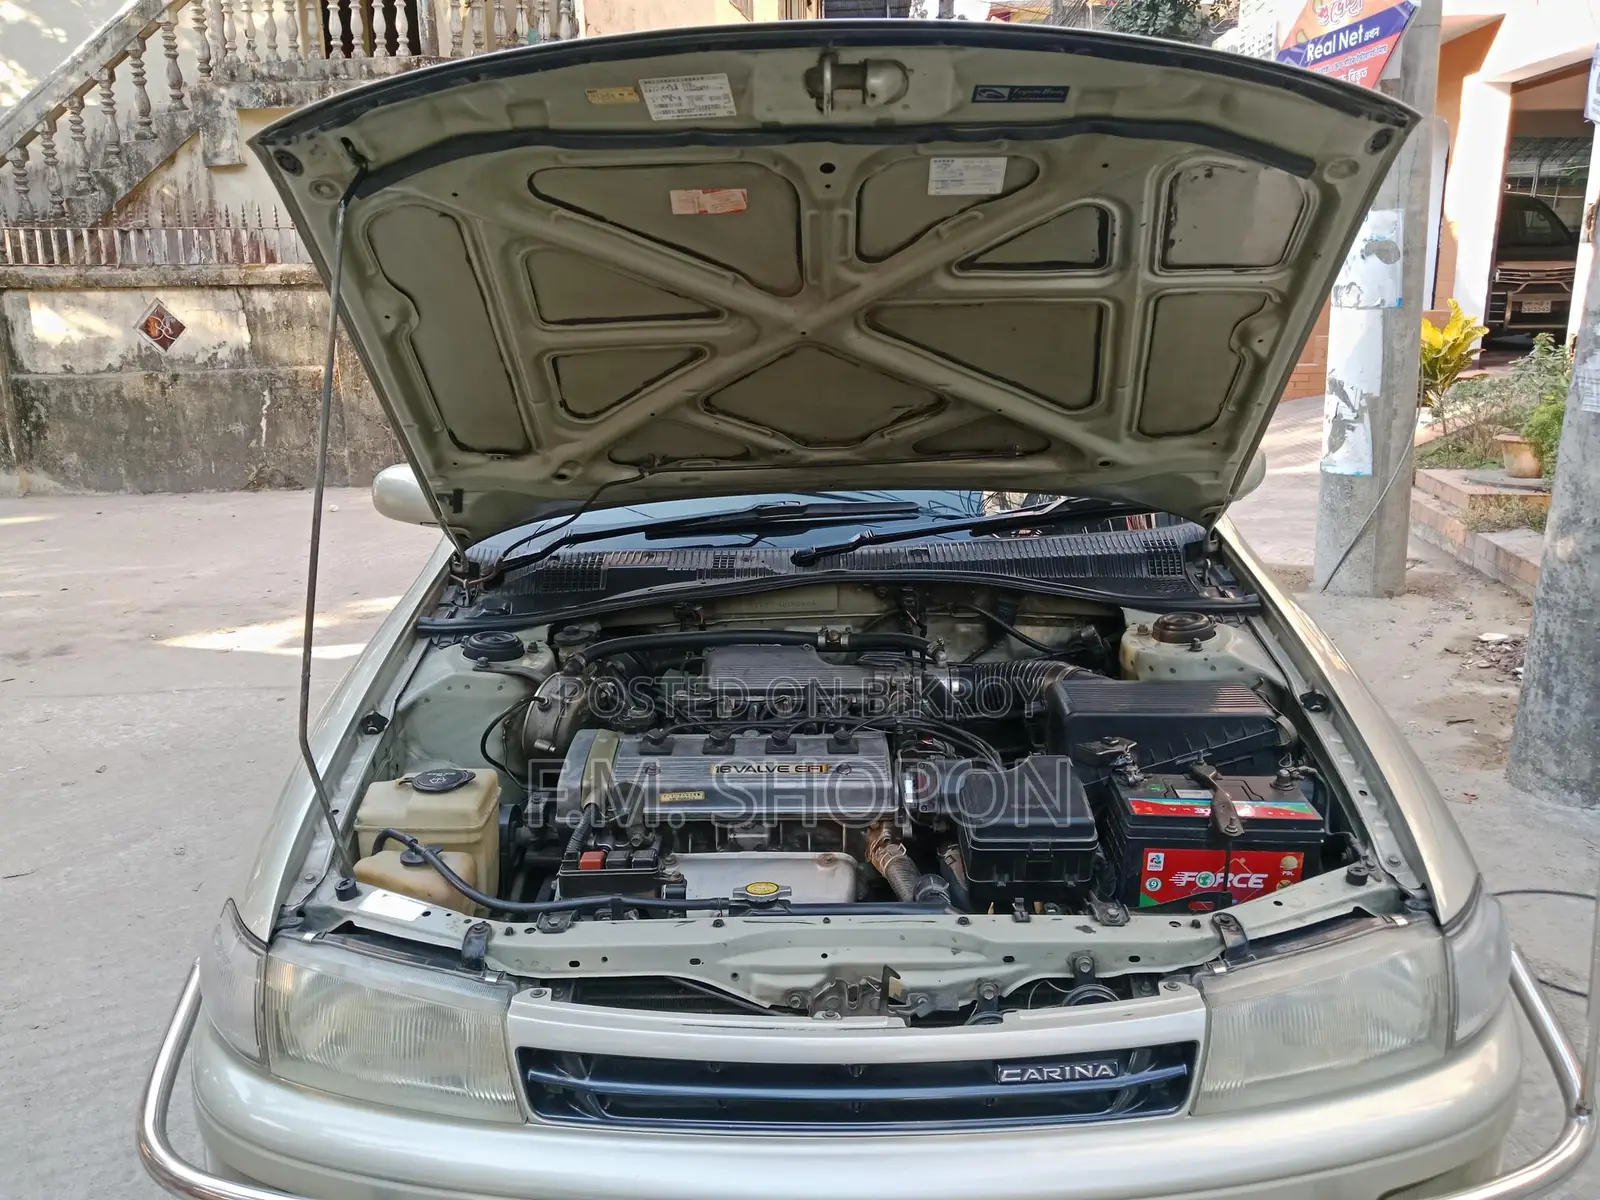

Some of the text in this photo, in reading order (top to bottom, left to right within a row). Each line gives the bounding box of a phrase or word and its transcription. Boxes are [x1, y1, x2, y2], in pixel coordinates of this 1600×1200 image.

[1306, 34, 1337, 62] Real
[1338, 24, 1364, 51] Net
[1169, 871, 1269, 888] FORCE
[1001, 1064, 1116, 1082] CARINA
